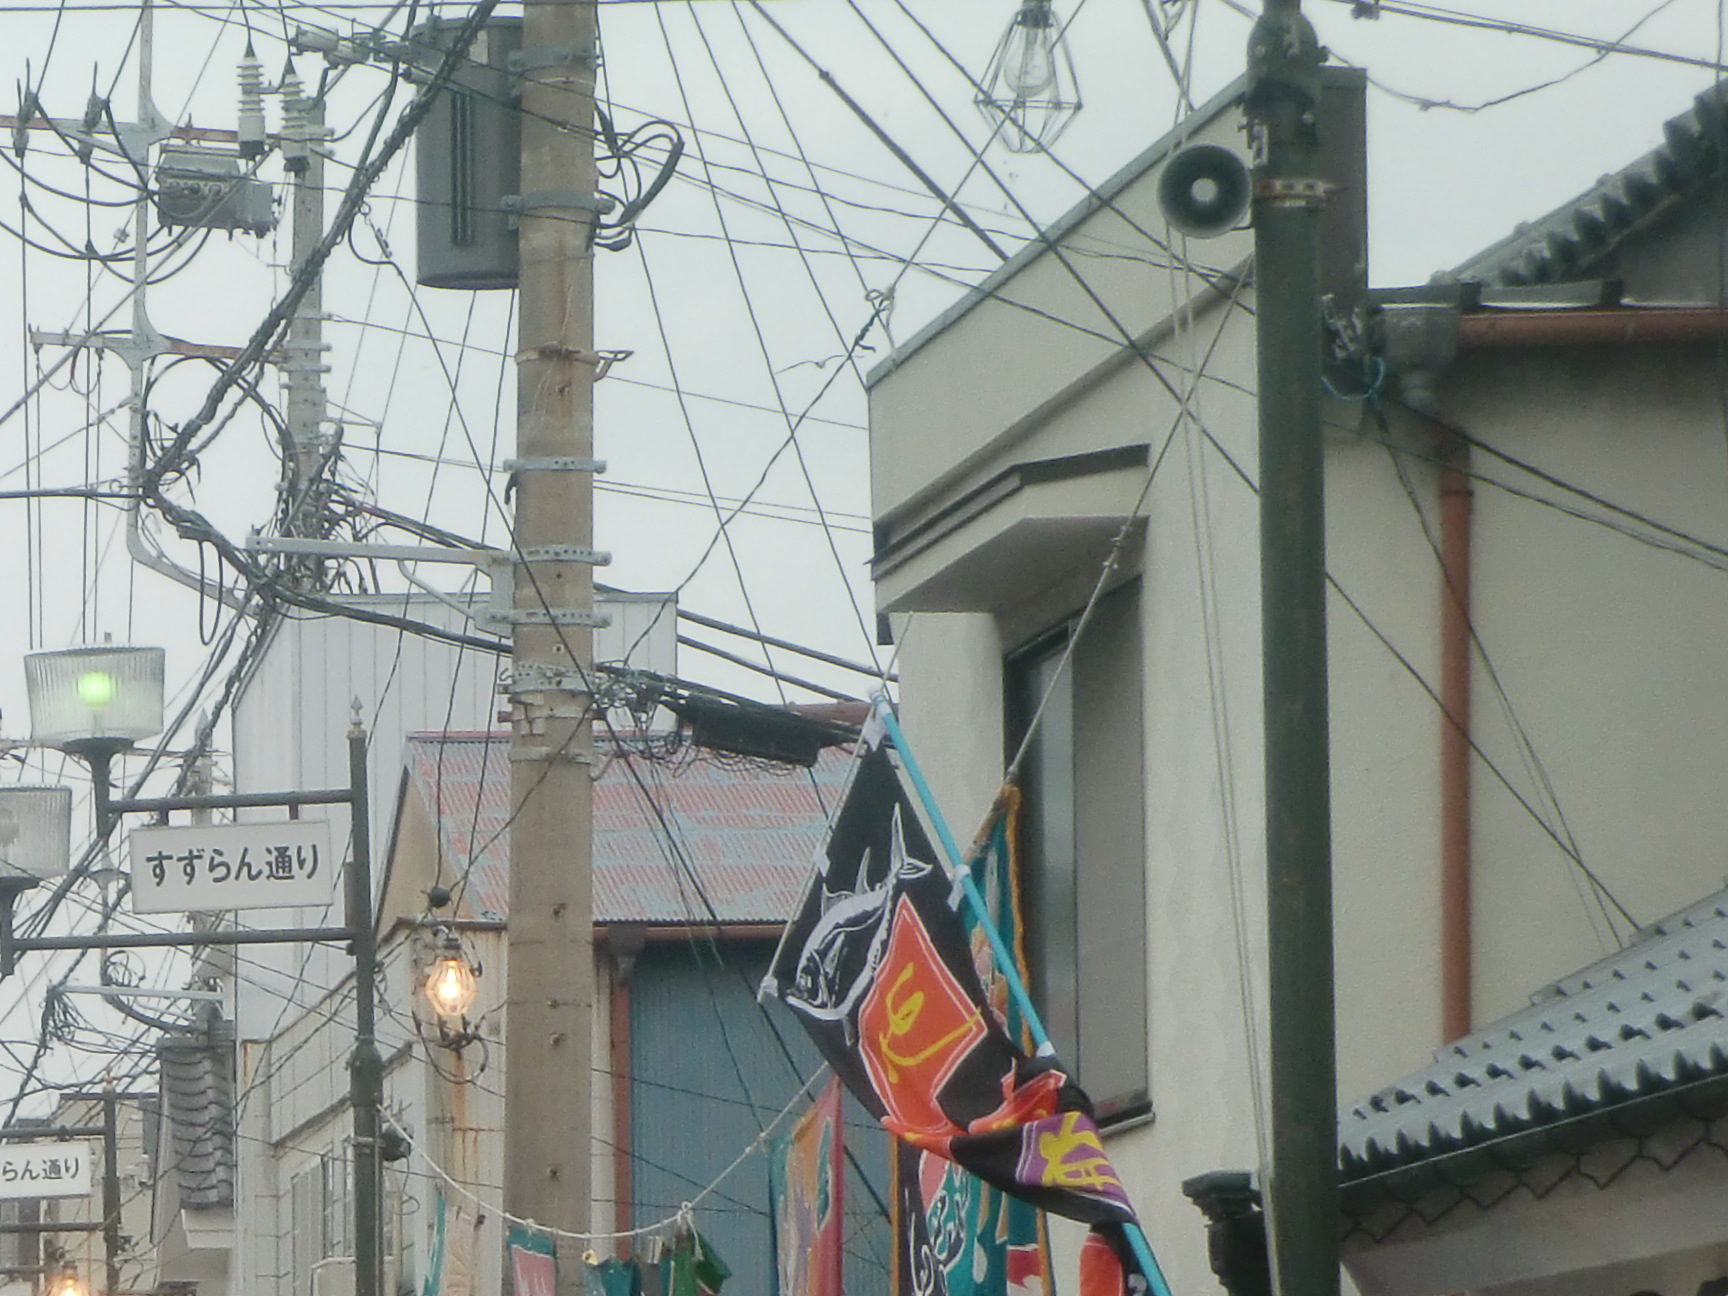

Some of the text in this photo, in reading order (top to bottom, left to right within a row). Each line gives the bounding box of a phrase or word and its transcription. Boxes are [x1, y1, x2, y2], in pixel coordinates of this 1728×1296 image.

[146, 843, 320, 887] すずらん通り
